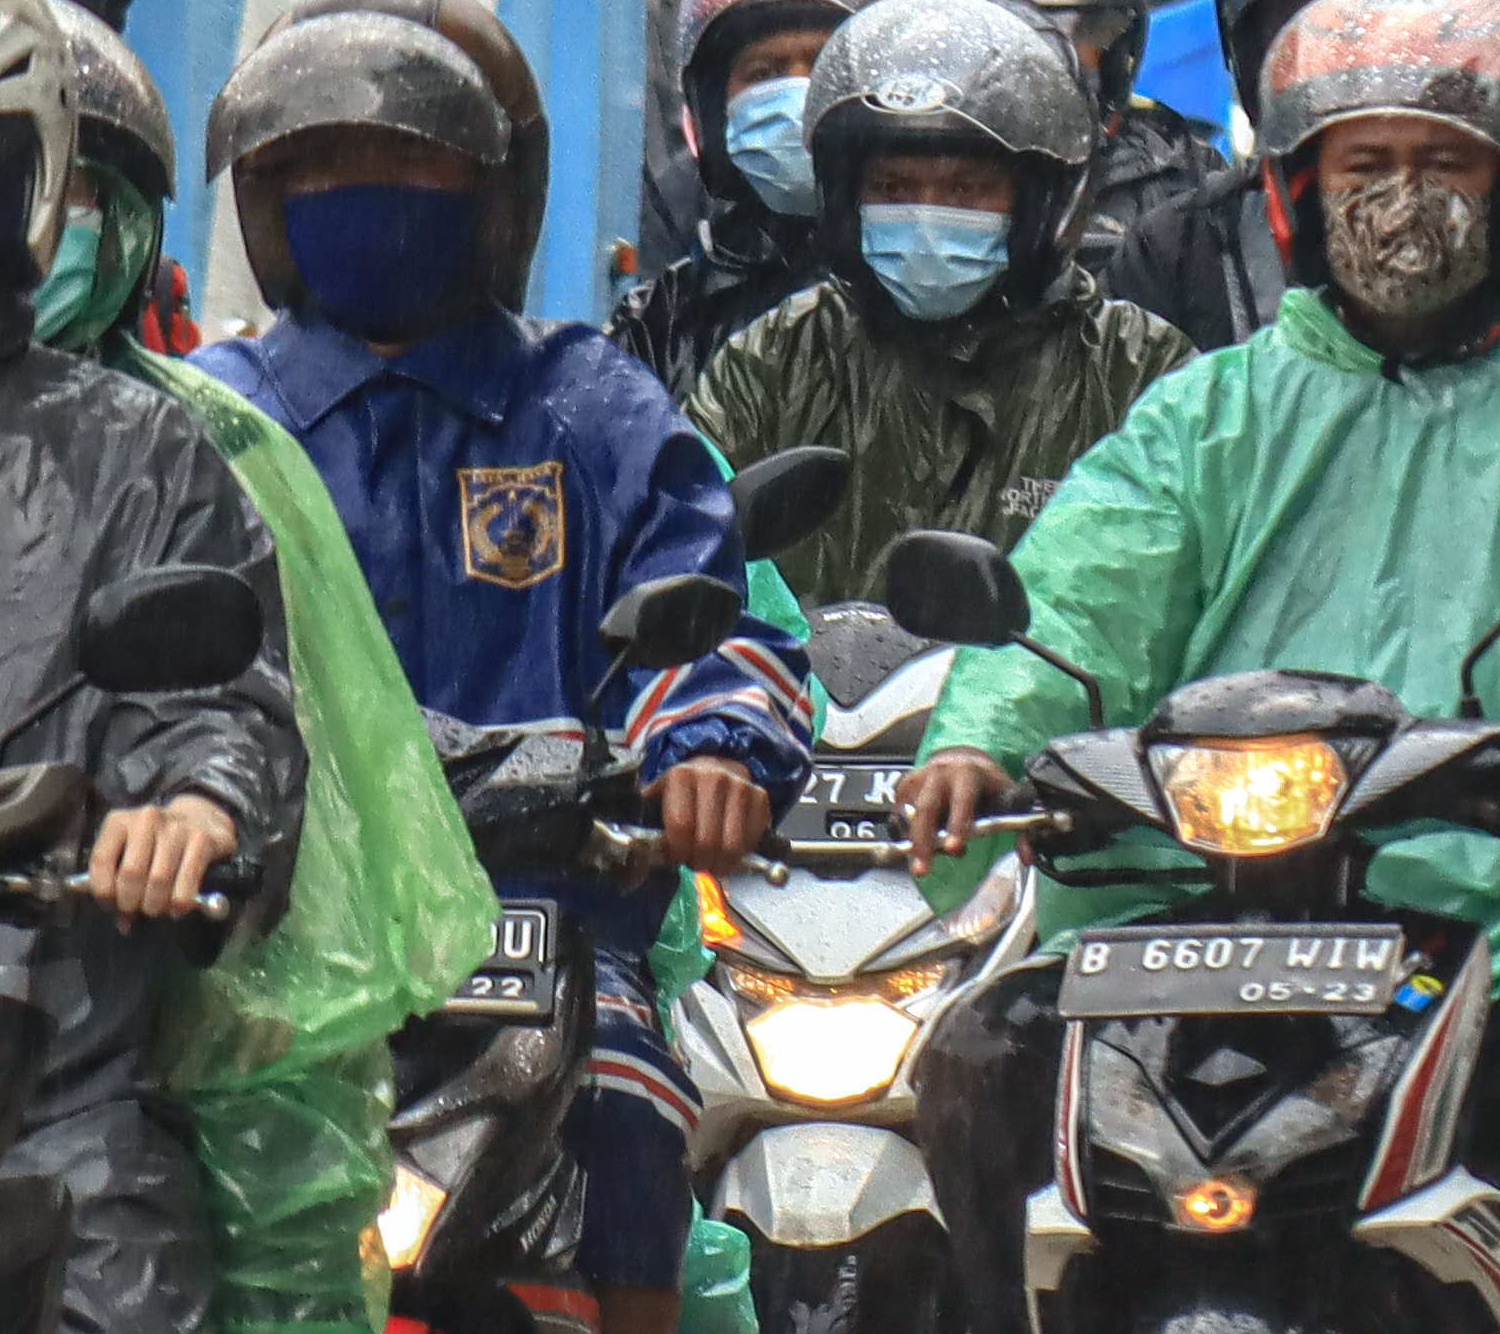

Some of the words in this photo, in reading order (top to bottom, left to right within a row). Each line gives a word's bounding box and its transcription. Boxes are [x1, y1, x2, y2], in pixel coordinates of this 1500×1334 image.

[1080, 942, 1111, 974] B
[1142, 938, 1265, 971] 6607
[1287, 937, 1393, 971] WIW
